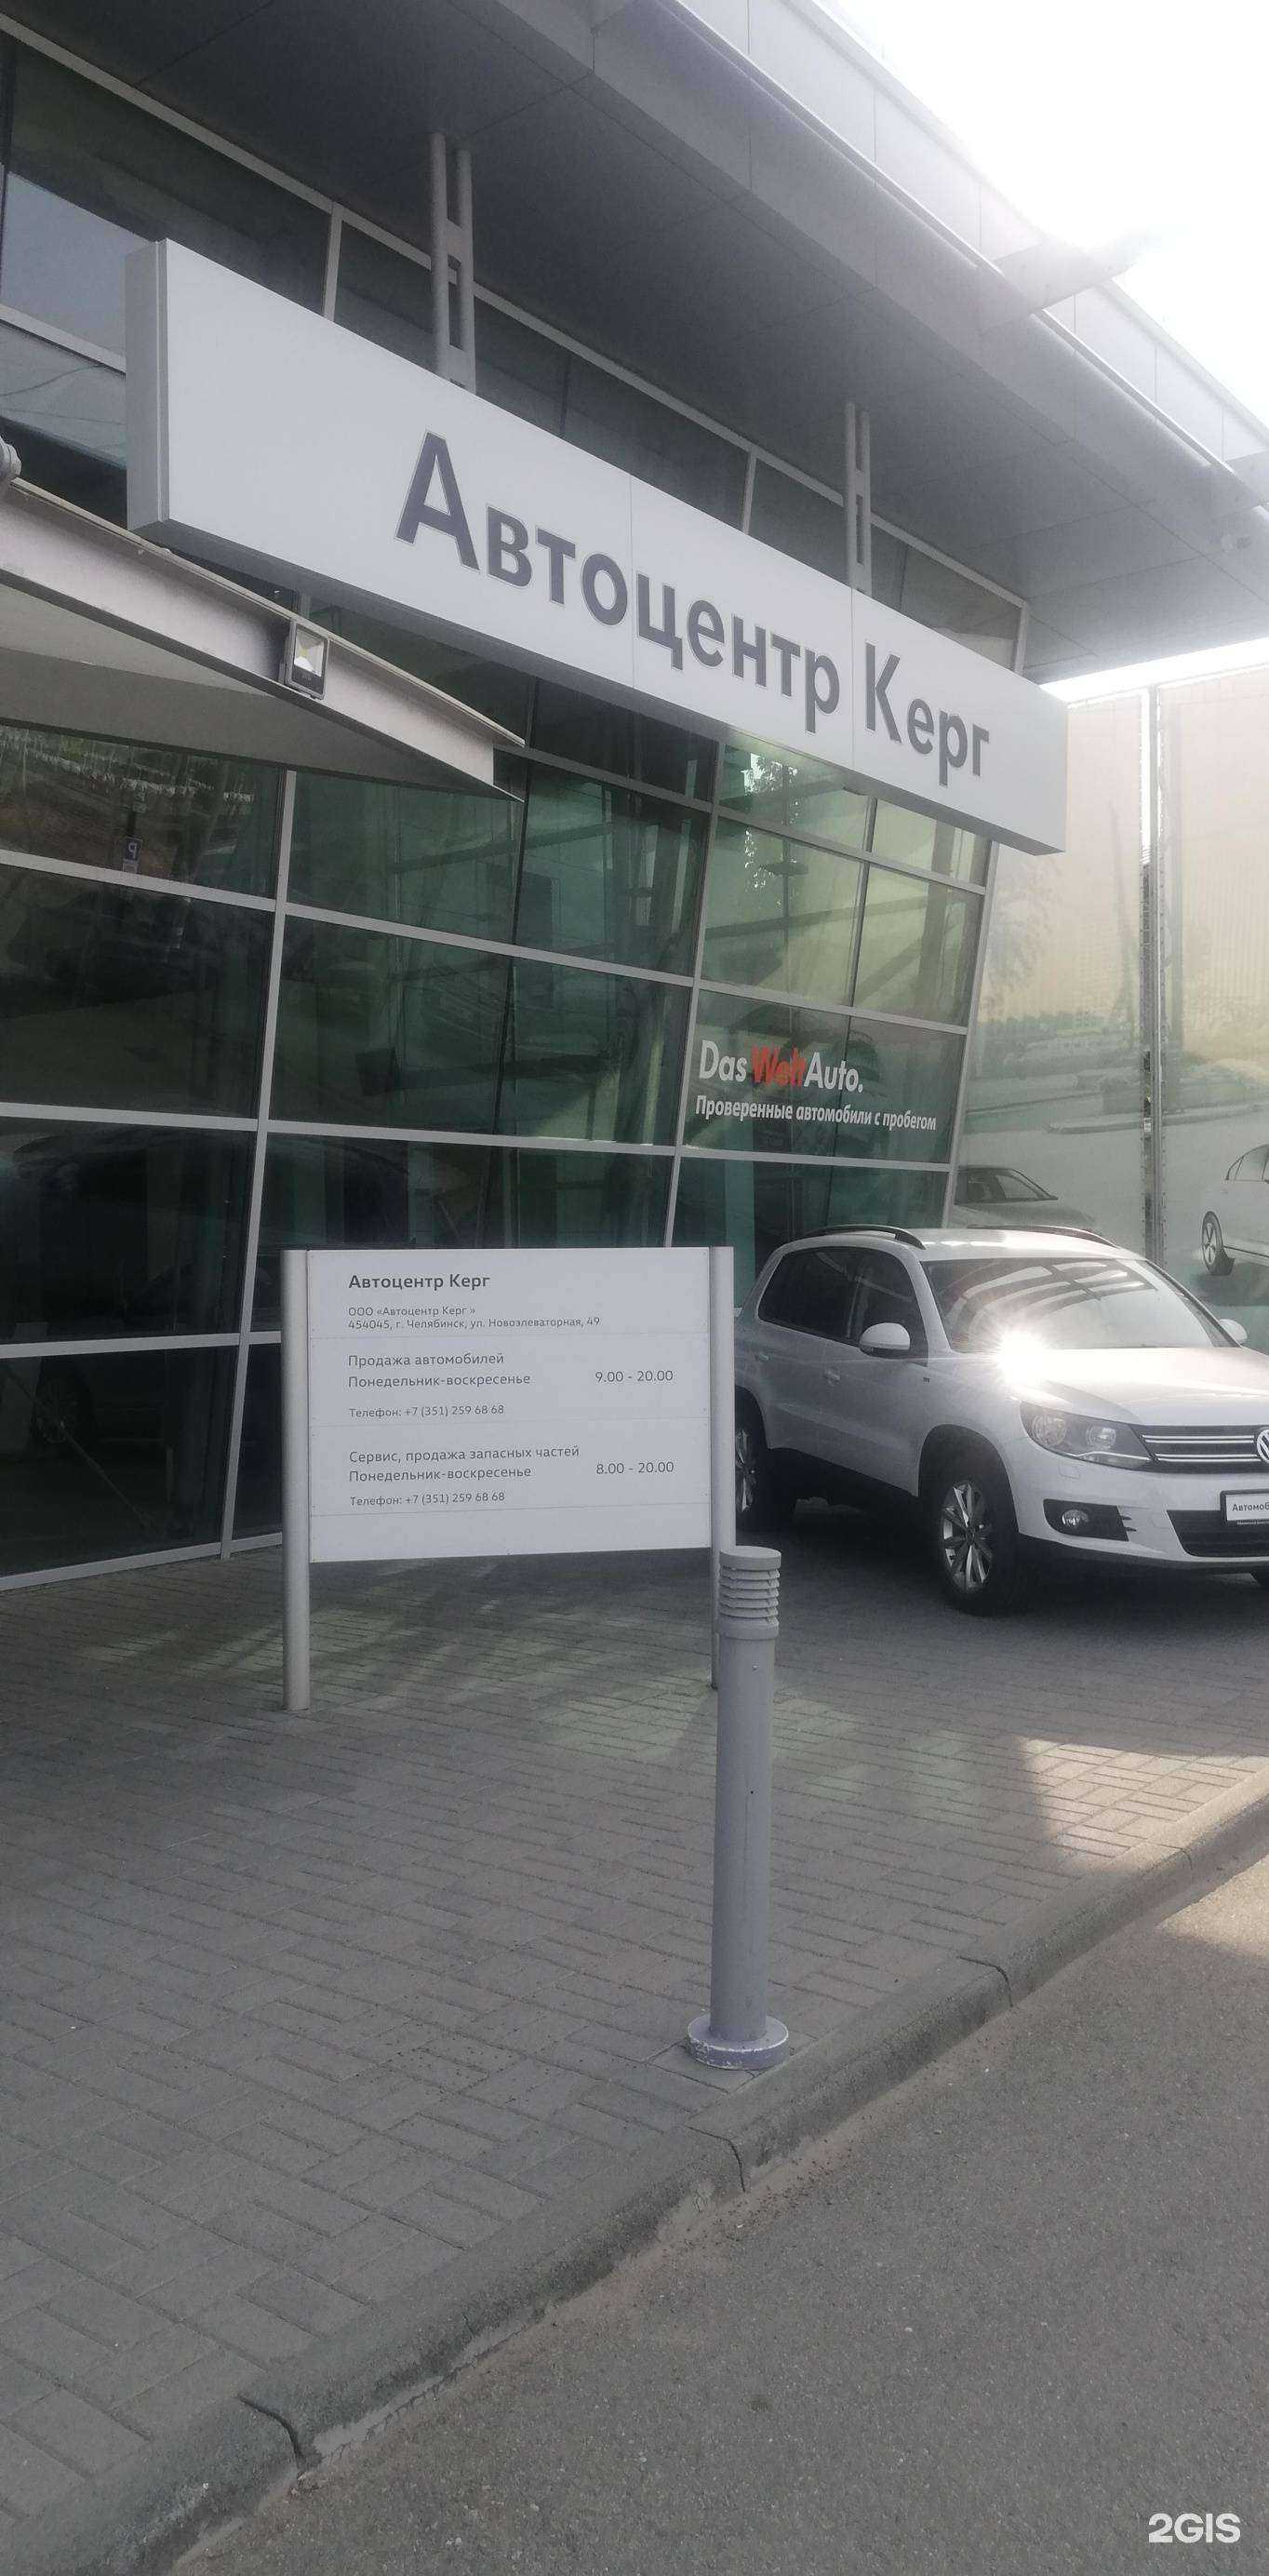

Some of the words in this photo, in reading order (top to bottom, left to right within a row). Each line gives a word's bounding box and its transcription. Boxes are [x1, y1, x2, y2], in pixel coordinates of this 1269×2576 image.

[394, 429, 840, 734] Автоцентр
[864, 642, 992, 787] Керг
[699, 1040, 748, 1082] Das
[696, 1095, 793, 1120] Проверенные
[795, 1105, 872, 1125] автомобили
[875, 1113, 881, 1126] с
[883, 1109, 937, 1132] пробегом
[348, 1274, 445, 1292] Автоцентр
[449, 1273, 491, 1291] Керг
[348, 1306, 374, 1317] ООО
[376, 1306, 440, 1317] «Автоцентр
[442, 1306, 467, 1316] Керг
[348, 1319, 394, 1331] 454045,
[407, 1318, 468, 1330] Челябинск,
[470, 1319, 487, 1329] ул.
[488, 1317, 584, 1329] Новоэлеваторная,
[586, 1317, 601, 1326] 49
[348, 1354, 411, 1368] Продажа
[414, 1352, 505, 1366] автомобилей
[348, 1375, 531, 1389] Понедельник-воскресенье
[594, 1371, 624, 1383] 9.00
[636, 1370, 674, 1381] 20.00
[349, 1407, 402, 1418] Телефон:
[404, 1406, 419, 1416] +7
[421, 1405, 448, 1418] (351)
[451, 1404, 472, 1415] 259
[474, 1404, 488, 1415] 68
[490, 1403, 505, 1414] 68
[349, 1450, 402, 1464] Сервис,
[405, 1450, 466, 1464] продажа
[469, 1448, 532, 1459] запасных
[535, 1444, 581, 1458] частей
[349, 1468, 532, 1483] Понедельник-воскресенье
[595, 1462, 625, 1475] 8.00
[637, 1461, 675, 1473] 20.00
[350, 1496, 402, 1507] Телефон:
[404, 1494, 419, 1505] +7
[421, 1494, 449, 1505] (351)
[452, 1493, 473, 1504] 259
[474, 1493, 489, 1502] 68
[491, 1492, 505, 1502] 68
